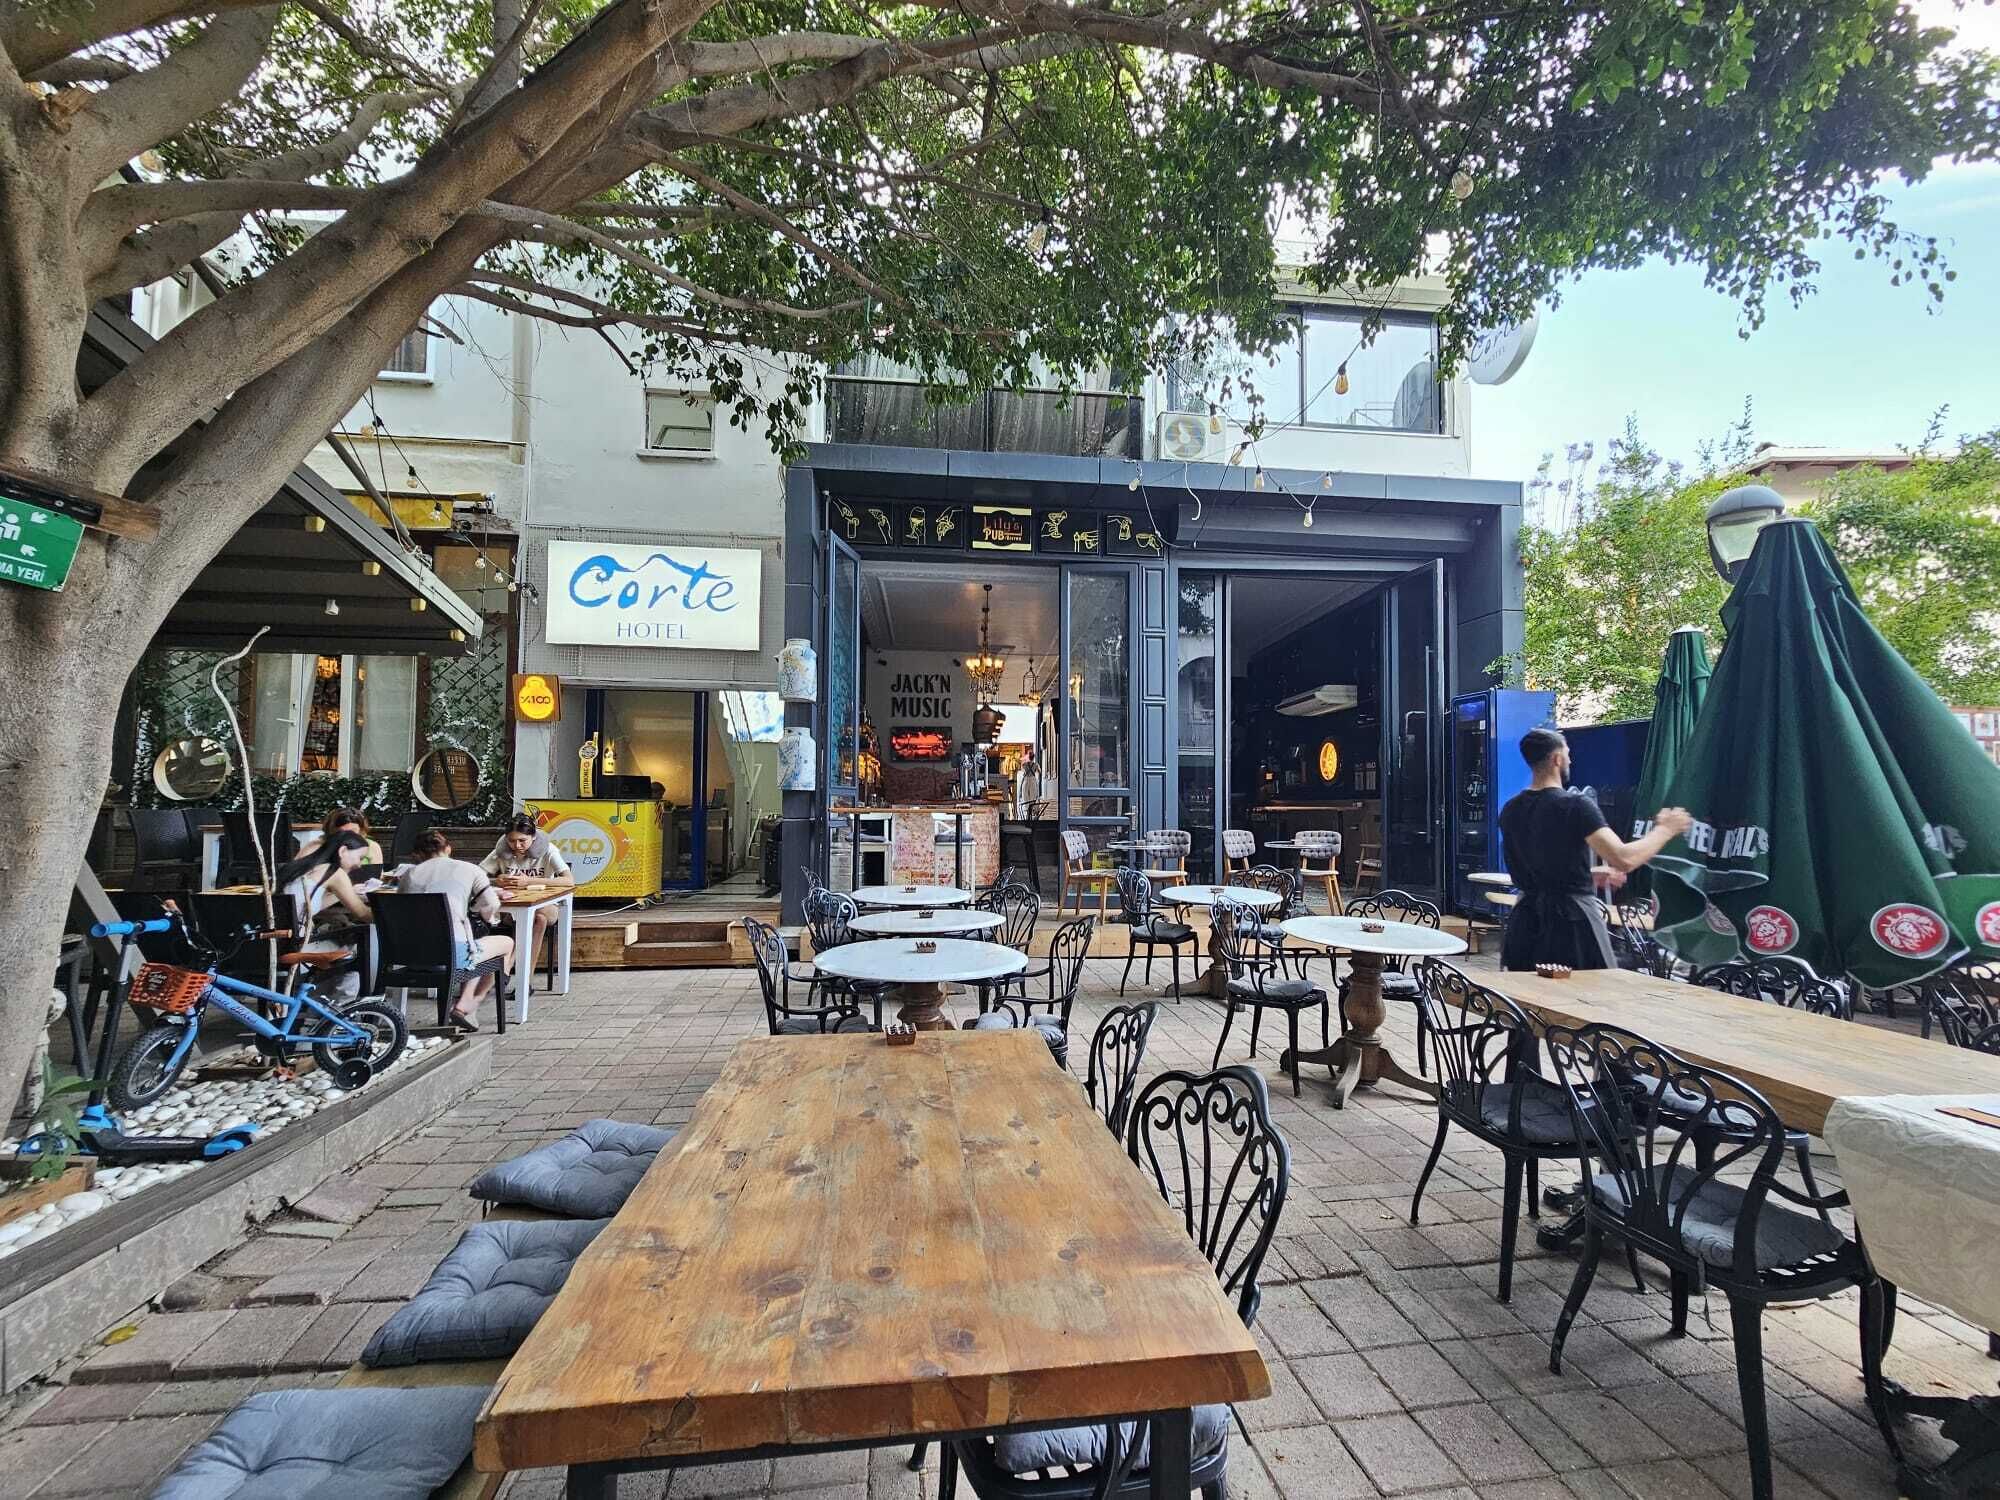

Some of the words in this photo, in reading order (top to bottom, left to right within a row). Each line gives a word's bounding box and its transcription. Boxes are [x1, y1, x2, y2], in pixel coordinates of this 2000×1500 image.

[983, 527, 1005, 541] PUB
[569, 553, 740, 612] Corte
[616, 622, 691, 640] HOTEL
[890, 674, 951, 694] JACK'N
[890, 697, 952, 718] MUSIC
[583, 853, 605, 865] bar
